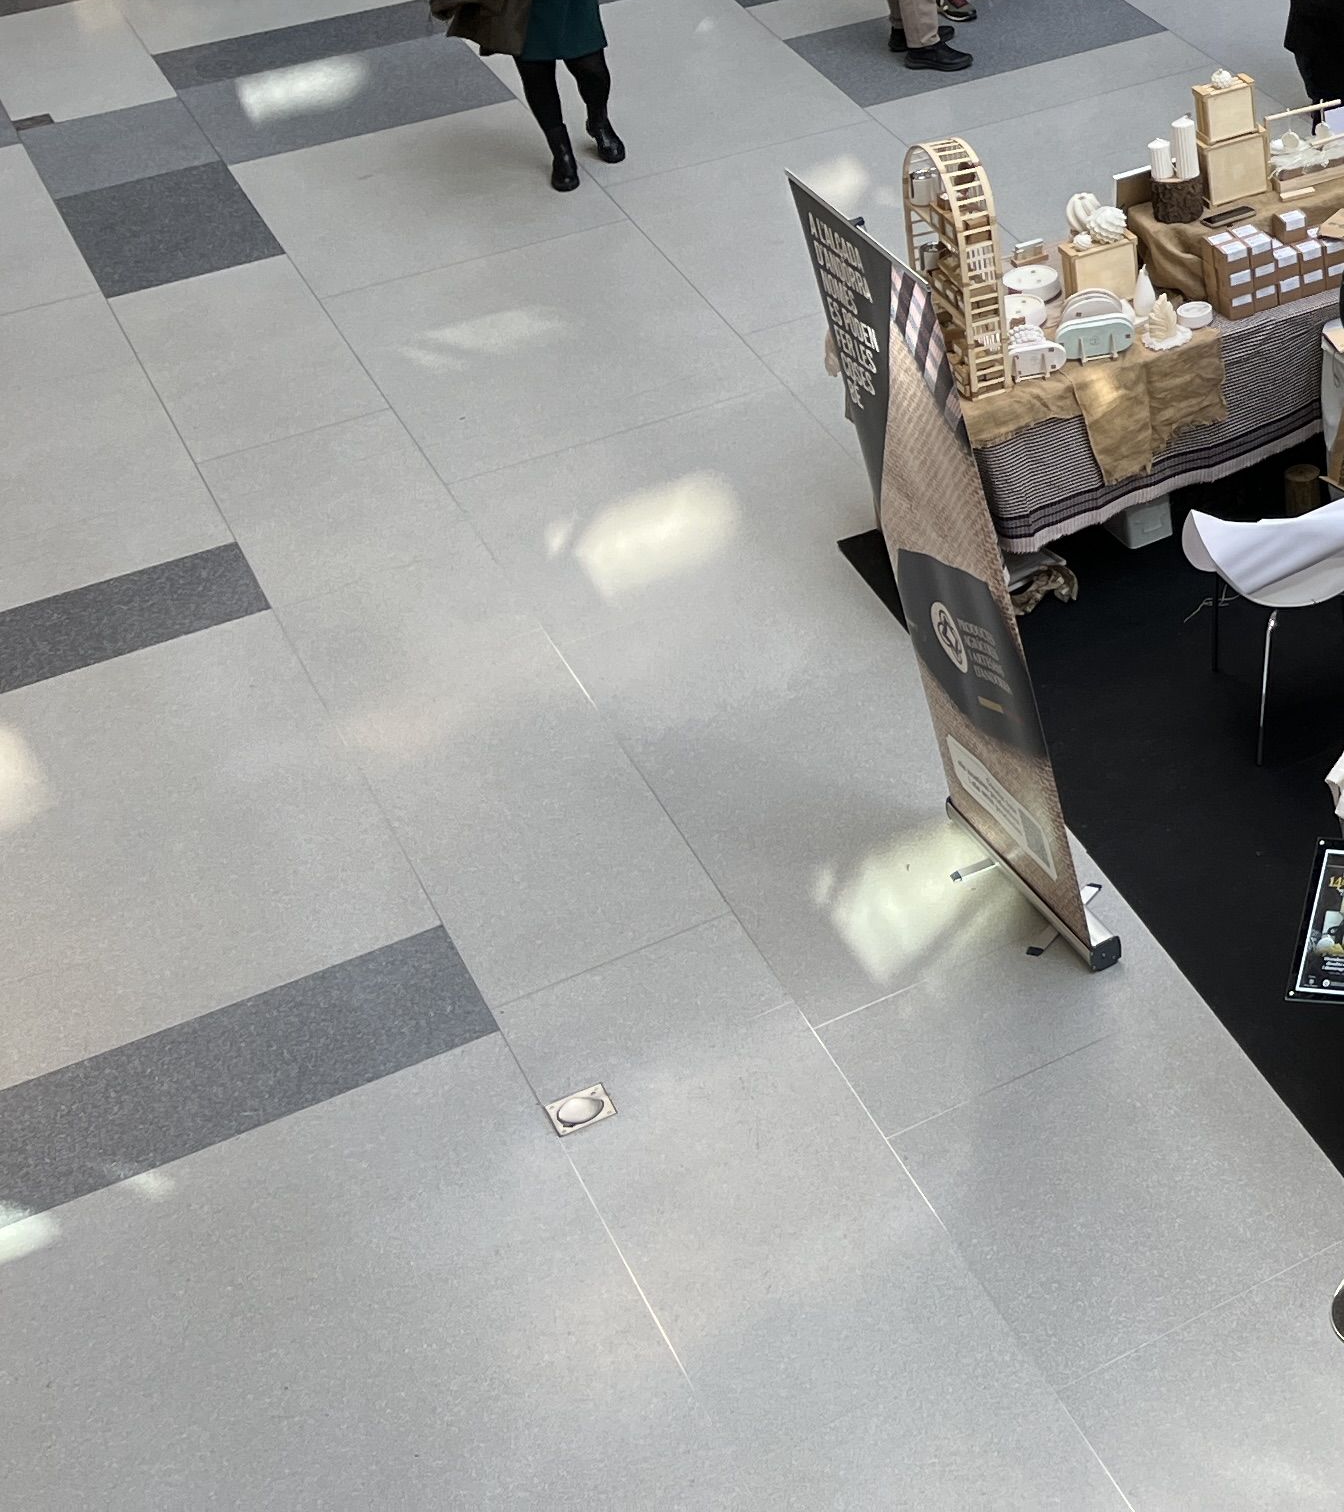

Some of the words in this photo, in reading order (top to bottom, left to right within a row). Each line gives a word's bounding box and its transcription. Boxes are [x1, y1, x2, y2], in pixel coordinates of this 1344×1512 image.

[826, 296, 843, 327] ES
[842, 307, 881, 353] PODEN
[834, 324, 855, 358] FER
[855, 341, 877, 375] LES
